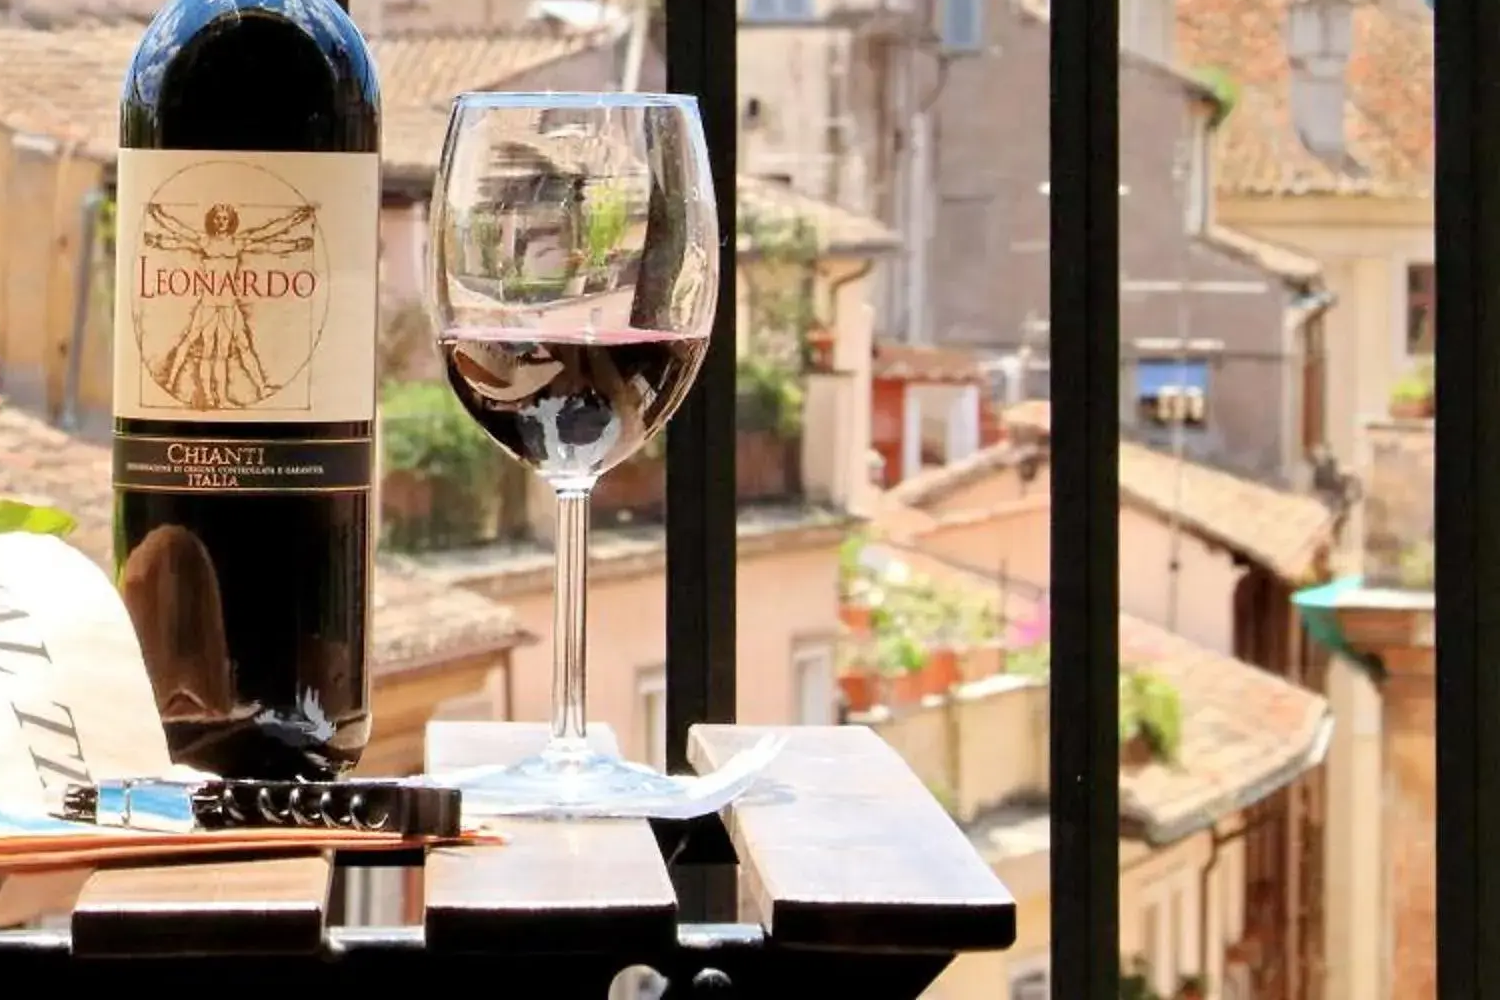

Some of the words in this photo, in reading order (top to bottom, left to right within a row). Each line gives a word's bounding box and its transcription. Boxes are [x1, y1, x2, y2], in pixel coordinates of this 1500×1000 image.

[139, 255, 316, 299] LEONARDO
[167, 443, 265, 466] CHIANTI
[187, 473, 240, 487] ITALIA
